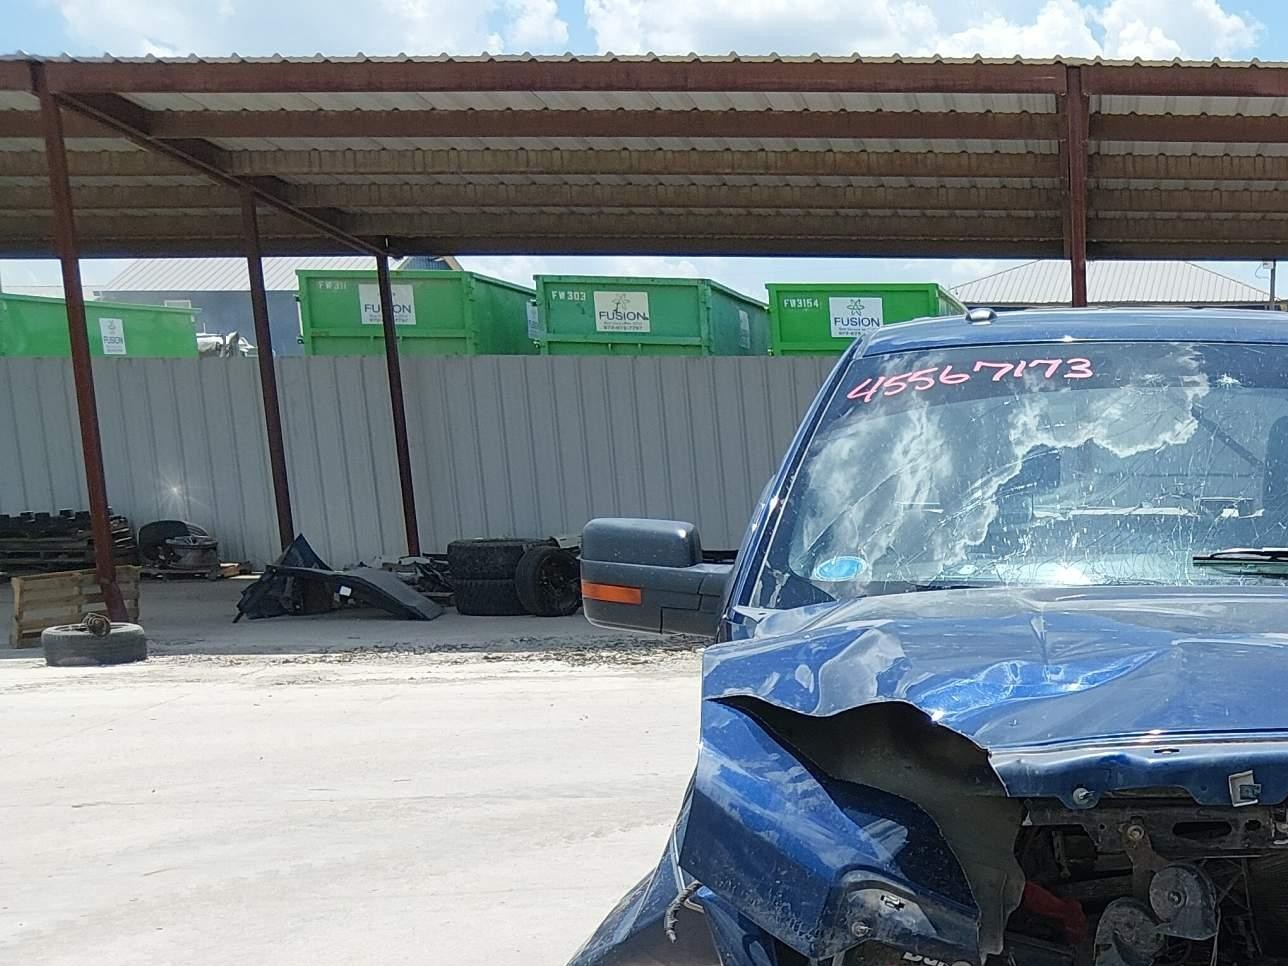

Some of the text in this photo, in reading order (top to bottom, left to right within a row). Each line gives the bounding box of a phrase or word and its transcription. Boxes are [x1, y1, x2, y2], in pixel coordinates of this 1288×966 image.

[364, 304, 412, 314] FUON
[599, 311, 646, 321] FUSION
[833, 317, 880, 327] FUSION
[846, 357, 1094, 403] 45567173
